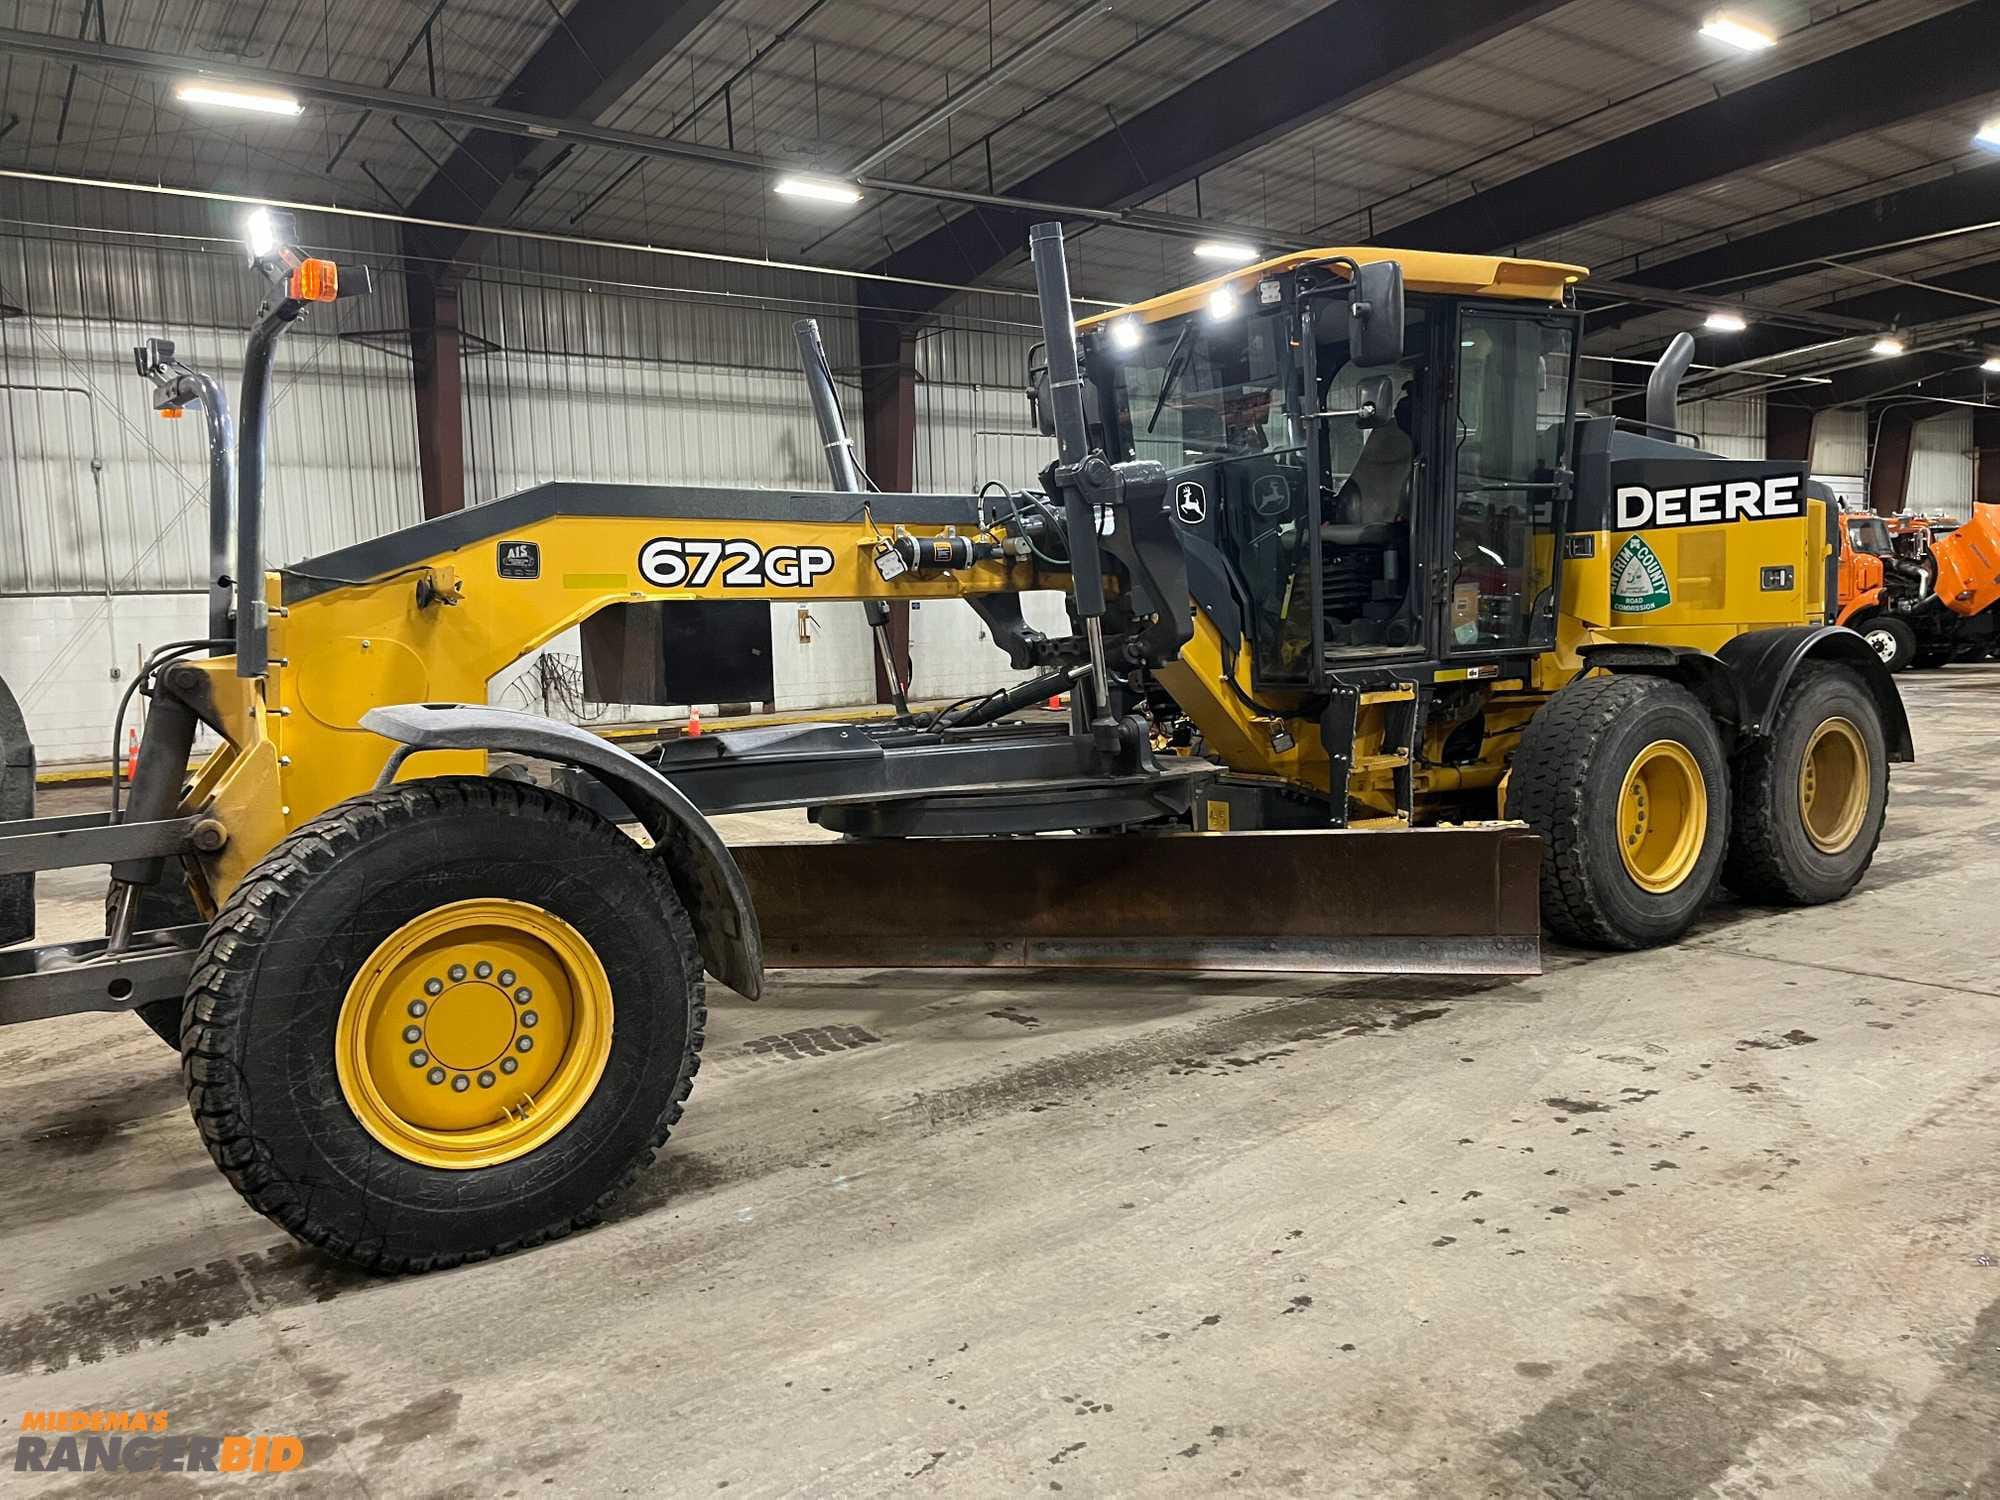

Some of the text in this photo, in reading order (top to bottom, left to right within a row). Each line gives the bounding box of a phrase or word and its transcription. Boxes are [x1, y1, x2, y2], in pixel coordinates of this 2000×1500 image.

[1617, 477, 1799, 529] DEERE
[640, 538, 833, 587] 672GP
[1637, 547, 1668, 594] COUNTY
[1614, 602, 1656, 611] COMMISSION
